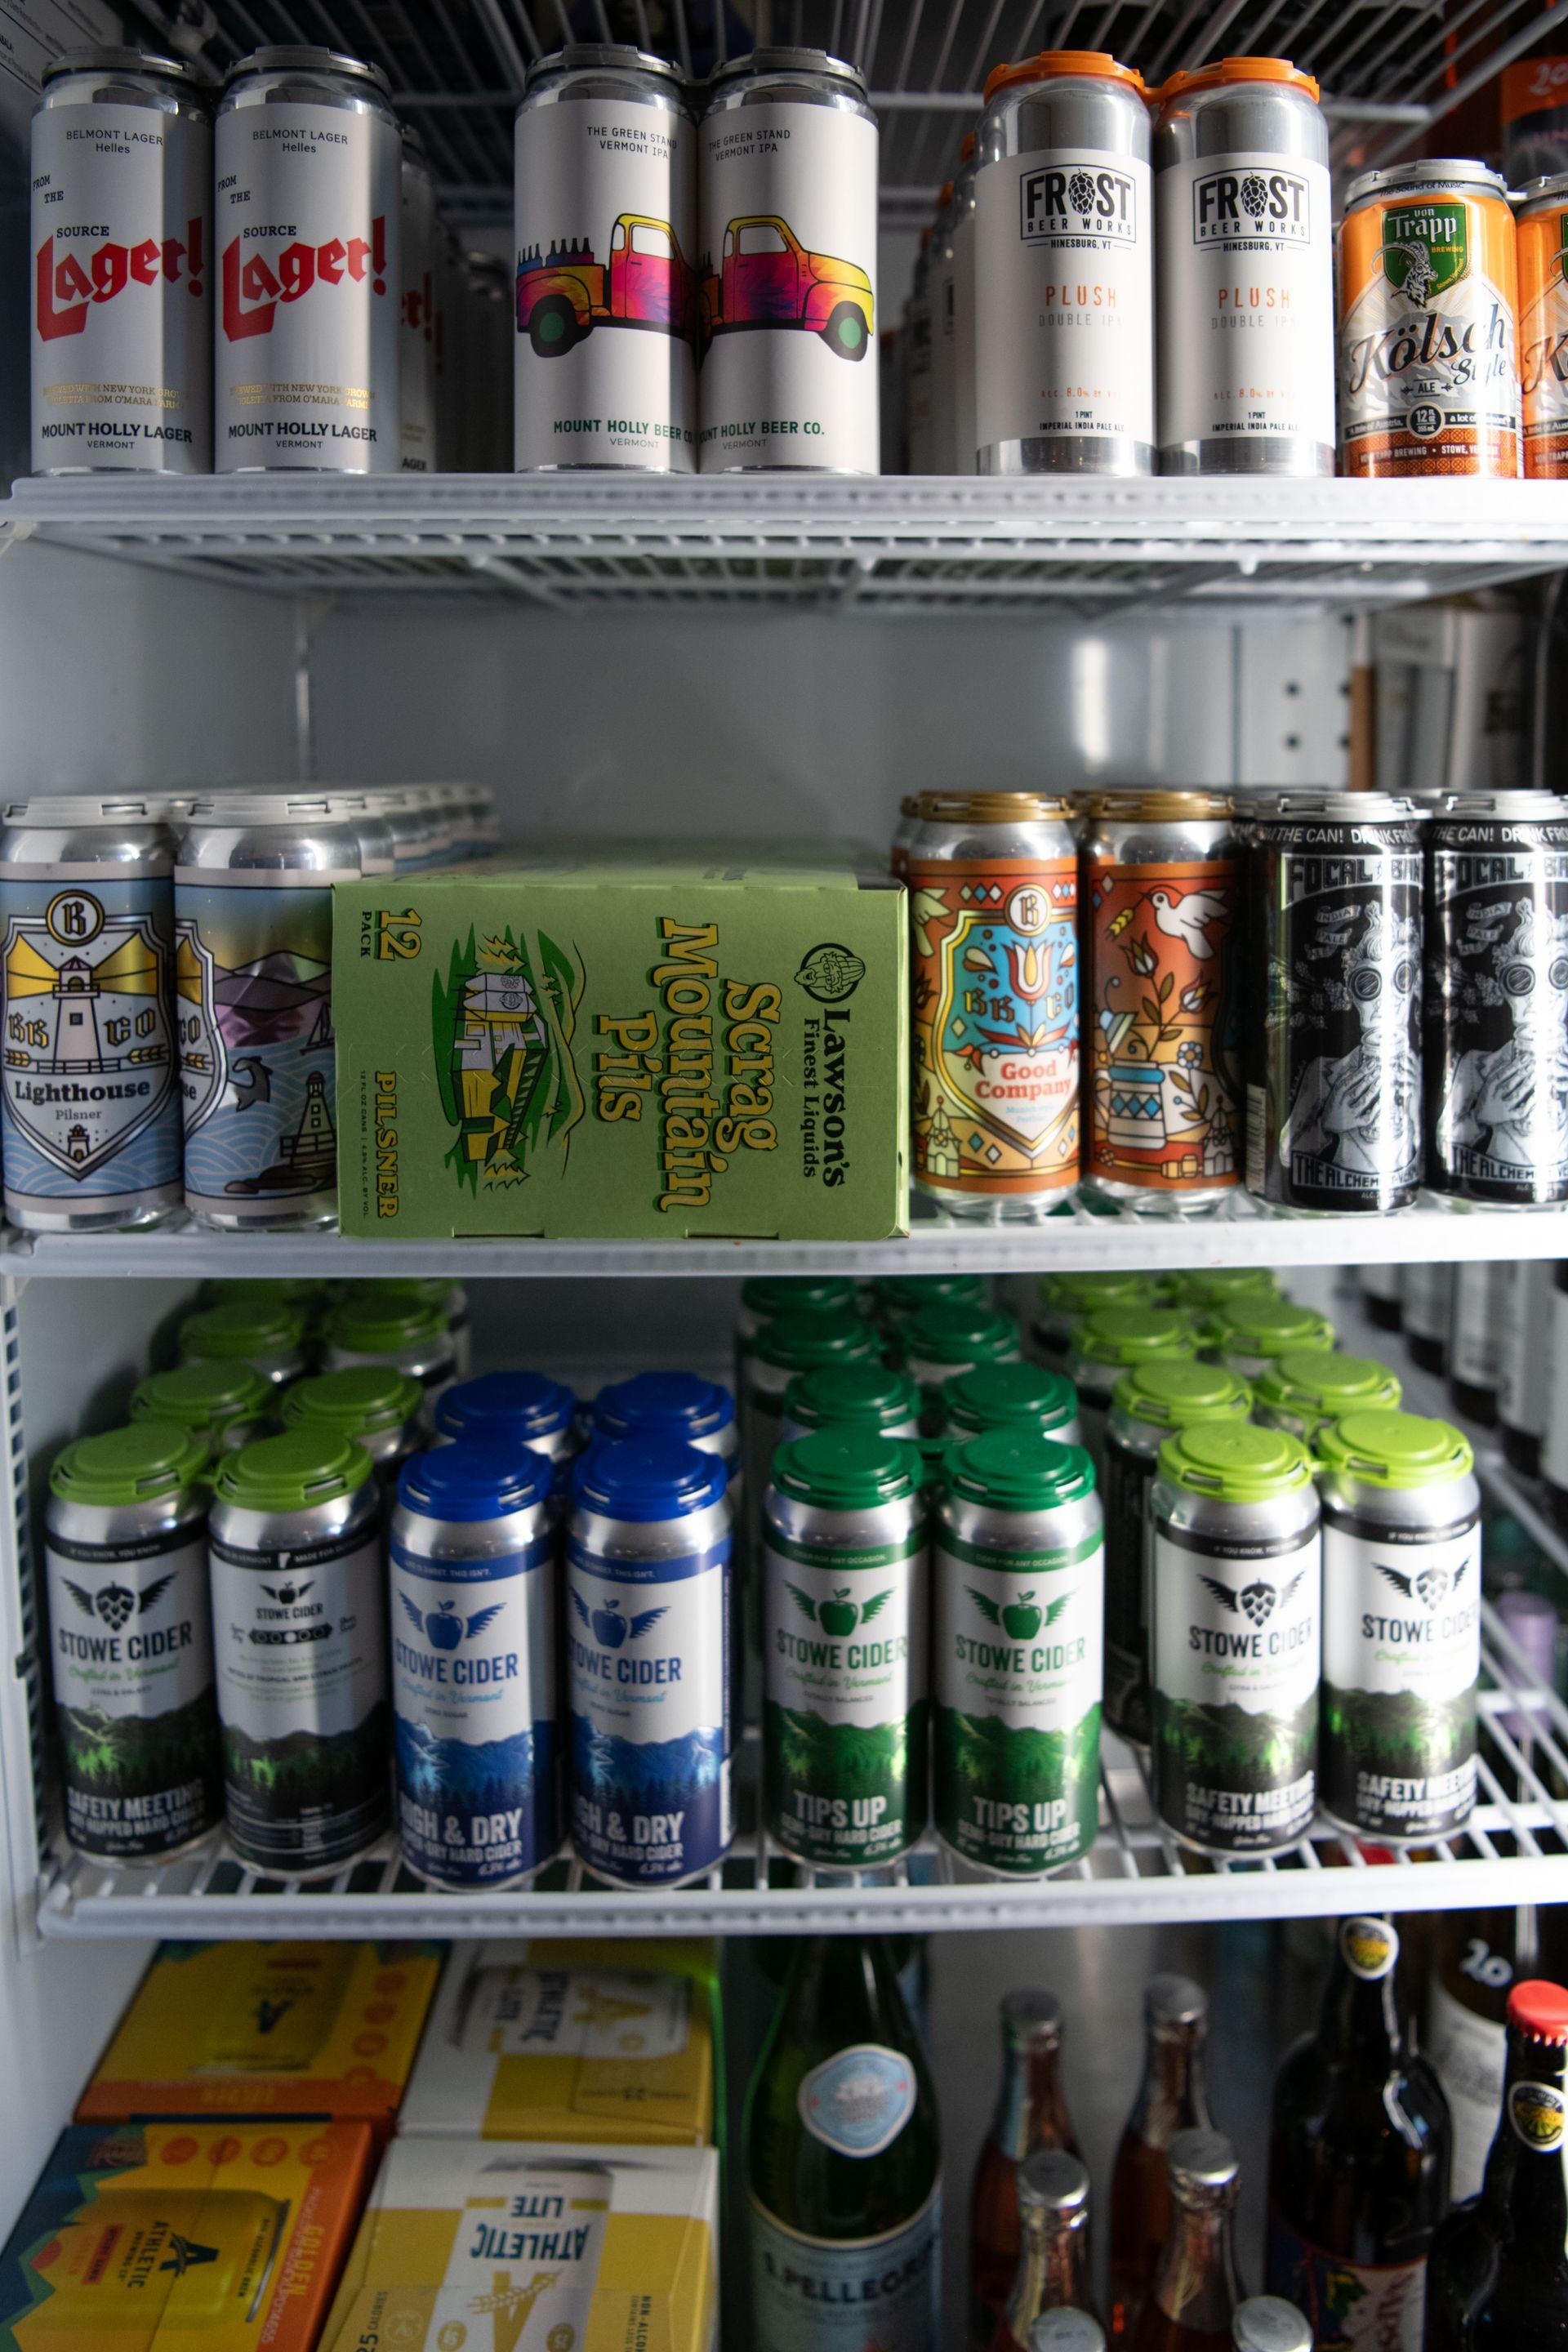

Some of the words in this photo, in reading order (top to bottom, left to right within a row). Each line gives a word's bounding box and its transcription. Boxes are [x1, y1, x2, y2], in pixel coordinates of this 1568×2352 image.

[66, 130, 120, 140] BELMONT
[124, 131, 163, 145] LAGER
[252, 129, 305, 140] BELMONT
[310, 130, 348, 145] LAGER
[587, 126, 608, 136] THE
[612, 127, 646, 140] GREEN
[650, 133, 677, 149] STAND
[709, 140, 721, 152] THE
[724, 131, 752, 145] GREEN
[756, 129, 791, 140] STAND
[96, 143, 131, 154] Helles
[282, 142, 316, 154] Helles
[599, 140, 648, 154] VERMONT
[653, 148, 668, 158] IPA
[715, 145, 755, 162] VERMONT
[759, 144, 777, 154] IPA
[33, 174, 51, 191] FROM
[218, 175, 237, 192] FROM
[44, 190, 64, 203] THE
[229, 190, 251, 204] THE
[1414, 208, 1435, 217] von
[56, 225, 109, 238] SOURCE
[243, 225, 296, 238] SOURCE
[1027, 217, 1068, 233] BEER
[1082, 217, 1132, 236] WORKS
[1200, 220, 1241, 237] BEER
[1255, 220, 1305, 237] WORKS
[1388, 213, 1457, 243] Trapp
[1050, 238, 1099, 250] HINESBURG,
[1102, 239, 1112, 250] VT
[1223, 241, 1272, 252] HINESBURG,
[1275, 242, 1285, 252] VT
[36, 216, 205, 342] Lager!
[222, 215, 386, 342] Lager!
[1045, 285, 1117, 307] PLUSH
[1218, 287, 1290, 309] PLUSH
[1039, 314, 1092, 327] DOUBLE
[1211, 314, 1265, 329] DOUBLE
[1349, 304, 1506, 394] Kölsch
[103, 385, 127, 394] NEW
[129, 385, 155, 394] YORK
[291, 383, 315, 393] NEW
[317, 384, 341, 394] YORK
[1418, 382, 1436, 394] ALE
[114, 395, 153, 406] O'MARA
[273, 395, 301, 403] FROM
[303, 395, 340, 405] O'MARA
[1080, 411, 1093, 419] PINT
[1416, 409, 1428, 422] 12
[42, 423, 85, 439] MOUNT
[88, 423, 141, 437] HOLLY
[144, 425, 193, 443] LAGER
[229, 423, 274, 439] MOUNT
[277, 422, 328, 436] HOLLY
[332, 425, 377, 443] LAGER
[554, 420, 602, 434] MOUNT
[607, 420, 649, 435] HOLLY
[654, 424, 682, 440] BEER
[720, 421, 756, 438] HOLLY
[761, 421, 799, 434] BEER
[804, 422, 826, 435] CO.
[1040, 422, 1072, 431] IMPERIAL
[1075, 421, 1094, 430] INDIA
[1096, 422, 1111, 431] PALE
[1114, 424, 1125, 432] ALE
[1213, 422, 1245, 432] IMPERIAL
[1248, 422, 1267, 430] INDIA
[1269, 423, 1285, 431] PALE
[87, 441, 135, 449] VERMONT
[276, 440, 323, 448] VERMONT
[609, 438, 659, 448] VERMONT
[722, 439, 768, 450] VERMONT
[1394, 446, 1428, 458] BREWING
[1441, 445, 1468, 455] STOWE,
[1276, 827, 1303, 842] THE
[1306, 827, 1344, 843] CAN!
[1352, 828, 1392, 844] DRINK
[1458, 826, 1494, 842] CAN!
[1501, 826, 1548, 843] DRINK
[1286, 858, 1373, 902] FOCAL
[1318, 910, 1352, 922] INDIA
[360, 911, 372, 957] PACK
[373, 908, 423, 961] 12
[648, 915, 728, 1213] Mountain
[803, 1018, 820, 1090] Finest
[592, 1010, 663, 1122] Pils
[715, 978, 782, 1154] Scrag
[1000, 1059, 1058, 1080] Good
[15, 1080, 150, 1106] Lighthouse
[822, 1008, 851, 1187] Lawson's
[975, 1078, 1071, 1101] Company
[56, 1107, 102, 1121] Pilsner
[375, 1071, 399, 1218] PILSNER
[800, 1094, 820, 1178] Liquids
[1295, 1152, 1324, 1184] THE
[1452, 1146, 1483, 1175] THE
[256, 1607, 289, 1620] STOWE
[292, 1603, 323, 1619] CIDER
[1361, 1614, 1435, 1642] STOWE
[59, 1628, 122, 1662] STOWE
[127, 1620, 193, 1660] CIDER
[777, 1628, 842, 1669] STOWE
[847, 1635, 907, 1670] CIDER
[1189, 1624, 1263, 1658] STOWE
[955, 1634, 1026, 1673] STOWE
[1031, 1636, 1085, 1673] CIDER
[453, 1652, 519, 1685] CIDER
[617, 1656, 682, 1685] CIDER
[1356, 1771, 1426, 1801] SAFETY
[67, 1786, 121, 1820] SAFETY
[793, 1788, 849, 1829] TIPS
[852, 1795, 887, 1828] UP
[1187, 1782, 1254, 1815] SAFETY
[973, 1796, 1030, 1833] TIPS
[1034, 1797, 1067, 1833] UP
[443, 1815, 466, 1846] &
[471, 1806, 523, 1846] DRY
[607, 1811, 628, 1842] &
[633, 1810, 685, 1845] DRY
[511, 2196, 565, 2218] LITE
[470, 2223, 591, 2261] ATHLETIC
[127, 2221, 169, 2288] ATHLETIC
[370, 2291, 388, 2331] CALORIES
